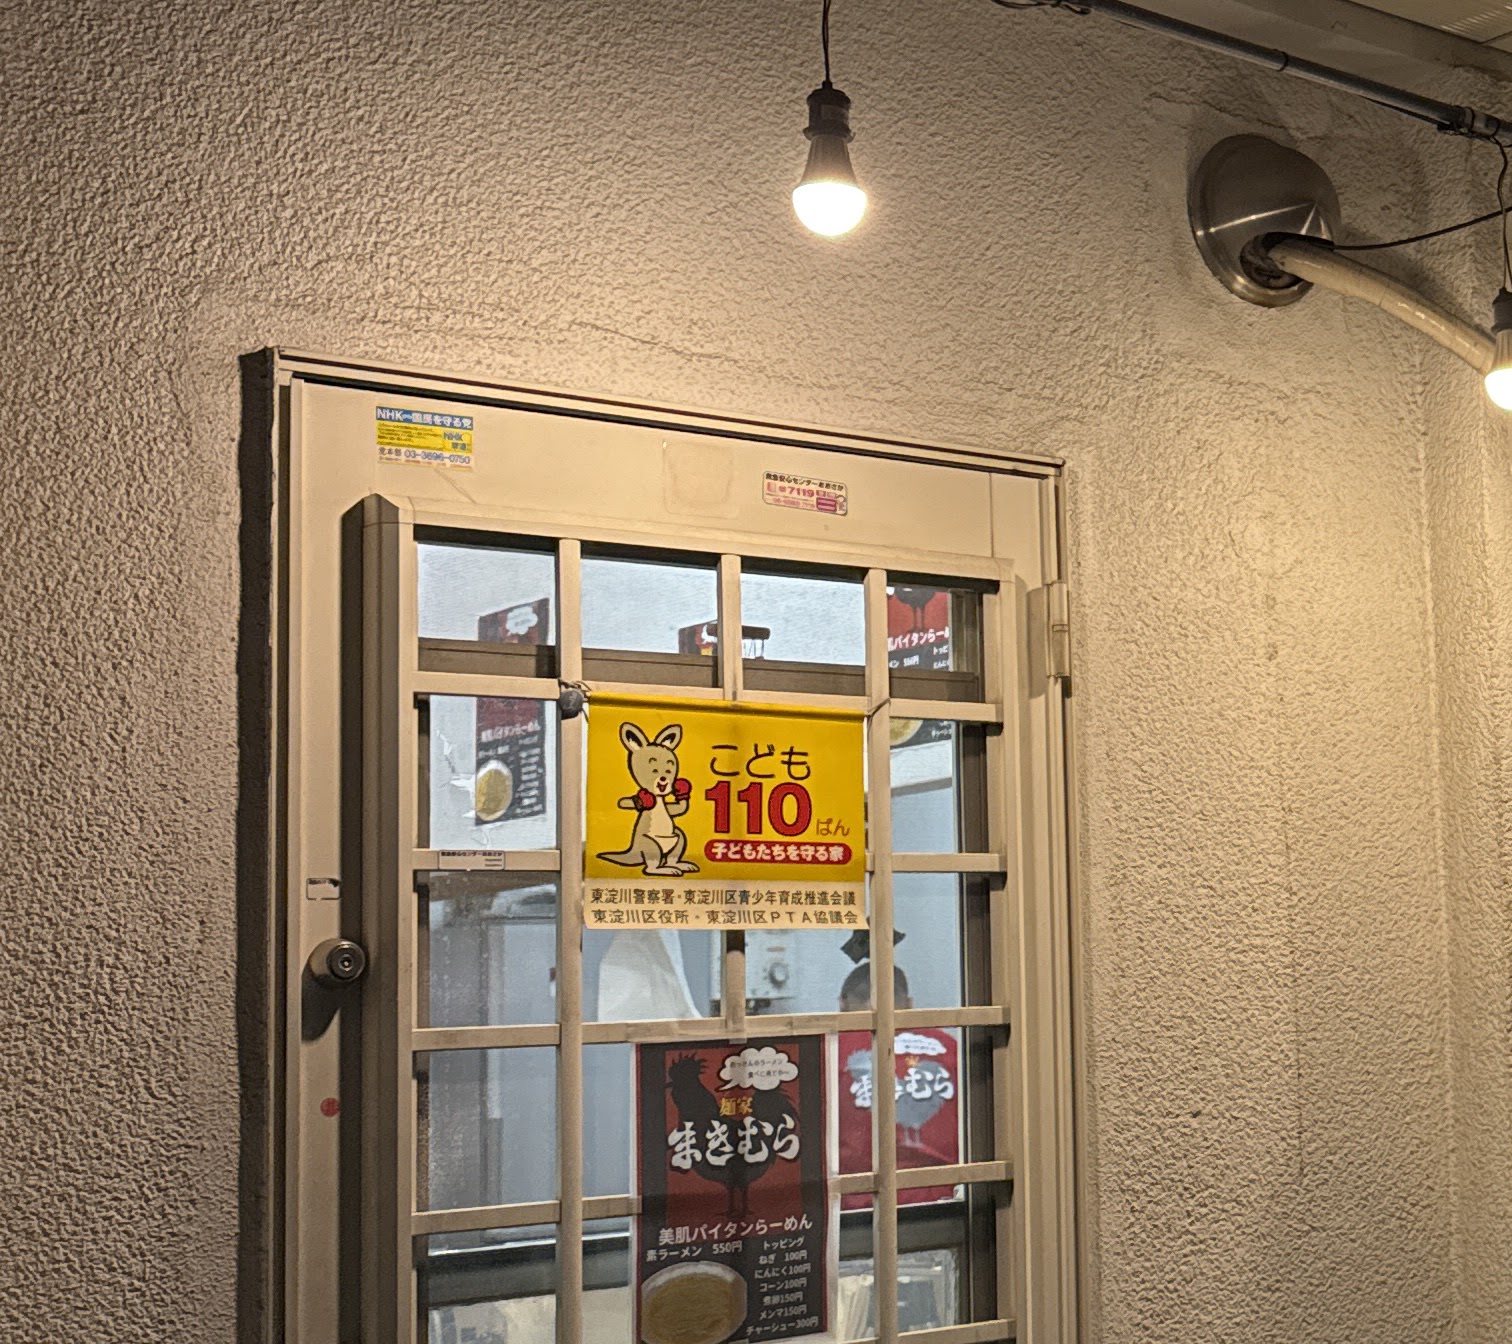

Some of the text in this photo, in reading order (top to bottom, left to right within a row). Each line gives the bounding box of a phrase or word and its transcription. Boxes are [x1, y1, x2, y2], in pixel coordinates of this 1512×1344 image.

[709, 743, 811, 780] こども
[704, 780, 813, 837] 110
[711, 842, 844, 862] 子どもたちを守る家
[667, 1113, 800, 1170] まきむら
[658, 1213, 813, 1246] 美肌パイタンらーめん
[763, 1236, 805, 1251] トッピング
[712, 1240, 743, 1255] 550円
